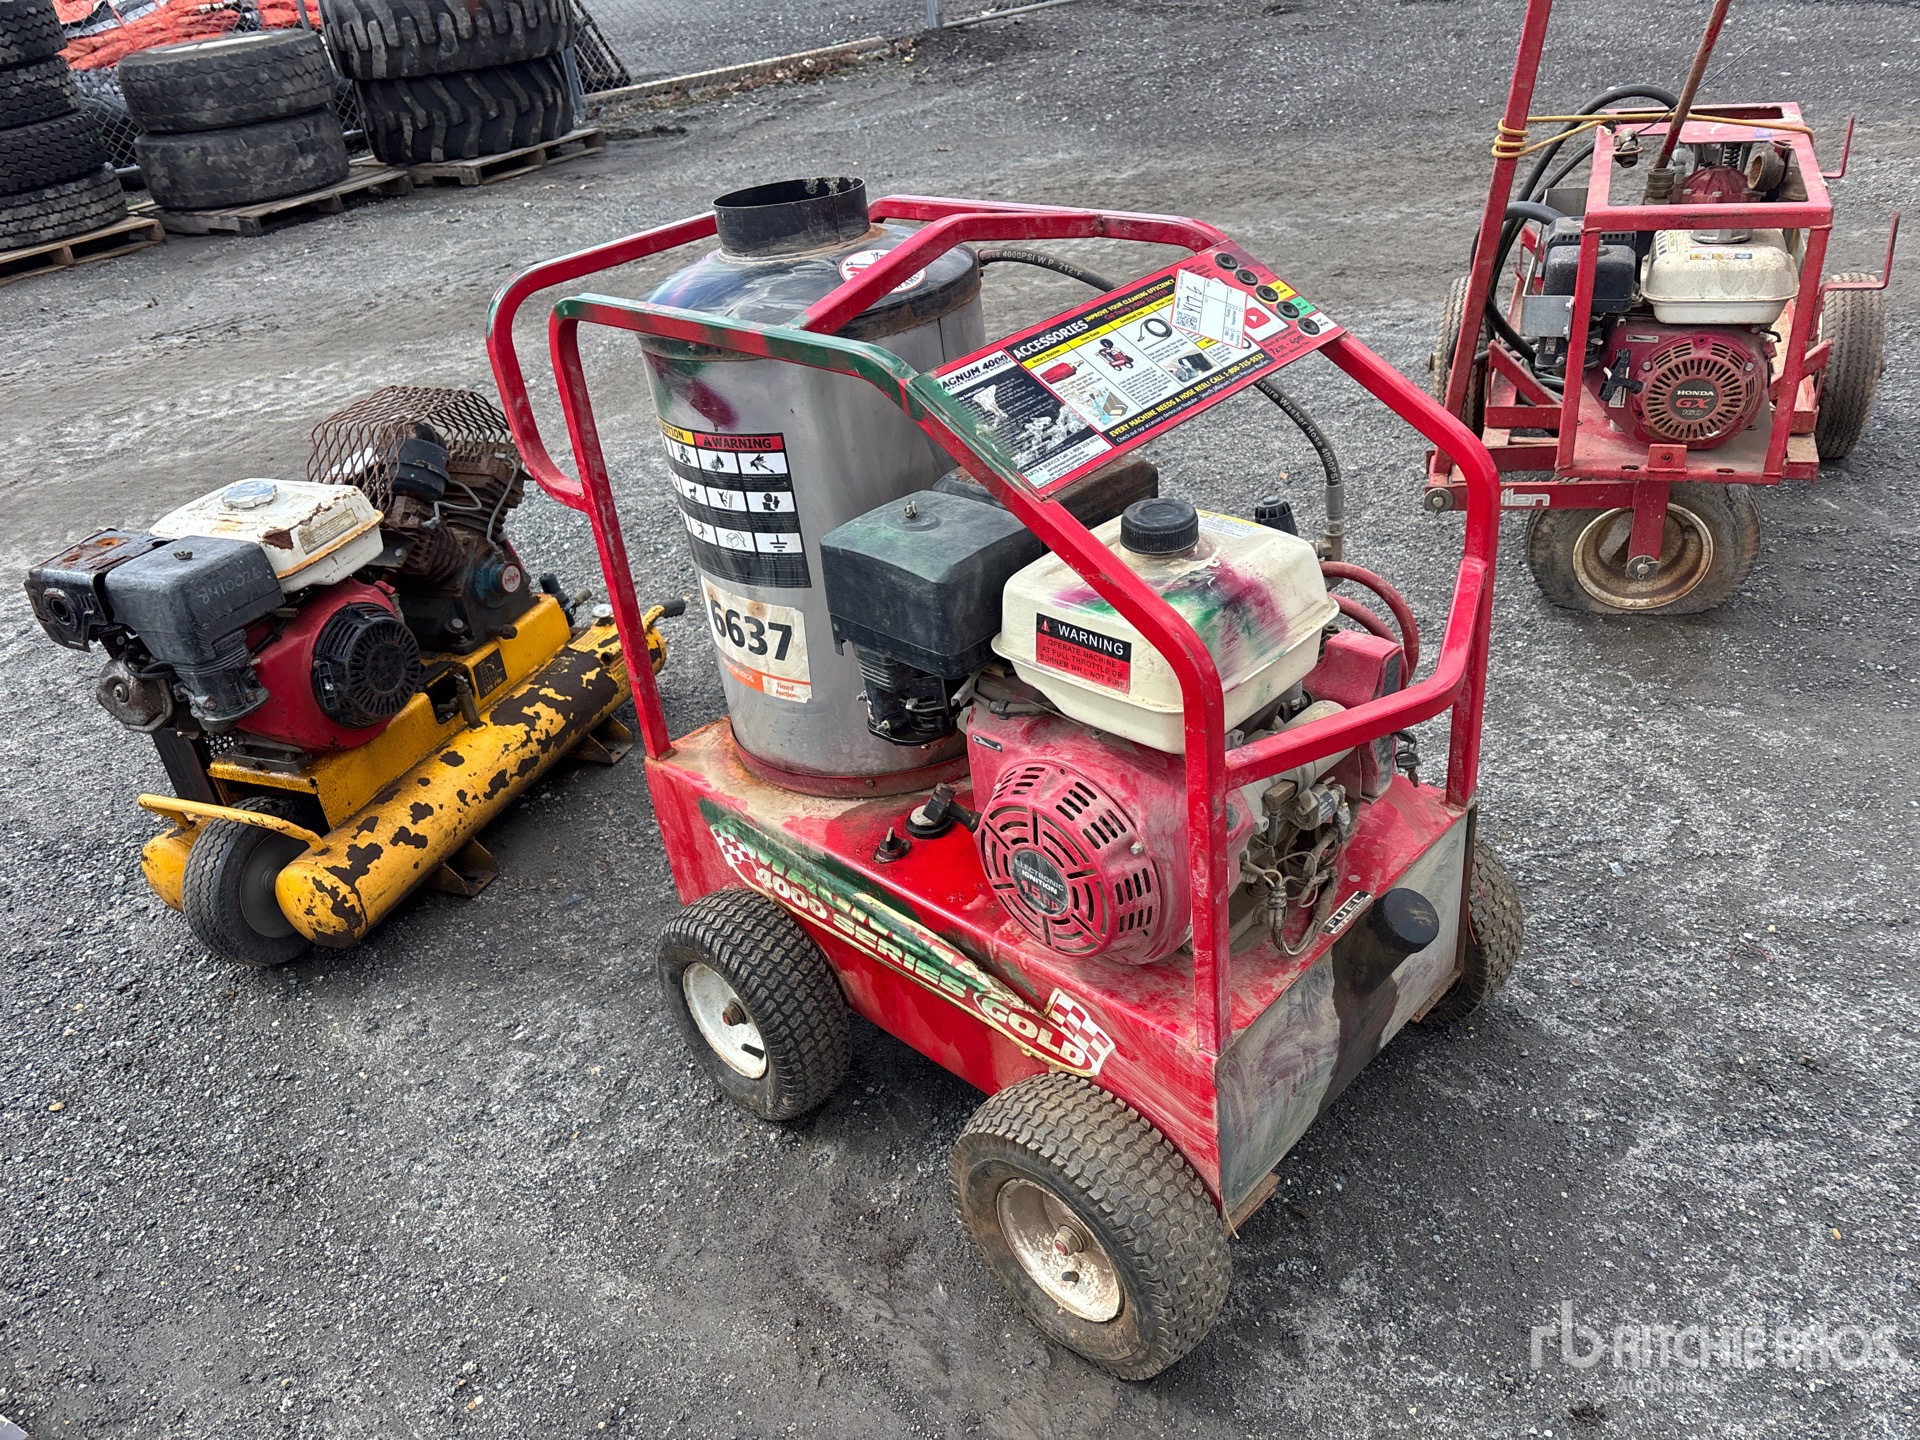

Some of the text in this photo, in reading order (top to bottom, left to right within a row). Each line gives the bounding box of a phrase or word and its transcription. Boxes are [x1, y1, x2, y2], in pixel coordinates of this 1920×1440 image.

[1002, 250, 1036, 262] 4000PSI
[1106, 301, 1124, 311] YOUR
[1120, 290, 1149, 304] CLEANING
[1145, 278, 1176, 294] EFFICIENCY
[1008, 319, 1090, 359] ACCESSORIES
[1267, 343, 1287, 354] 7am
[979, 353, 1009, 371] 4000
[1108, 423, 1131, 437] EVERY
[1127, 409, 1158, 426] MACHINE
[1154, 399, 1177, 412] NEEDS
[1178, 388, 1197, 400] HOSE
[1193, 380, 1212, 392] REEL!
[1208, 373, 1225, 383] CALL
[1221, 352, 1265, 376] 1-800-315-5533
[1675, 397, 1712, 409] GX
[711, 437, 772, 449] WARNING
[1279, 396, 1308, 427] Washer
[1305, 424, 1323, 447] Hose
[1321, 447, 1339, 483] 4000PSI
[710, 599, 793, 661] 6637
[1058, 623, 1124, 656] WARNING
[1040, 653, 1069, 669] BURNER
[1071, 664, 1088, 676] WILL
[1090, 671, 1105, 681] NOT
[1041, 645, 1123, 679] AT FULL THROTTLE OR
[1048, 638, 1117, 668] OPERATE MACHINE
[775, 689, 798, 699] Auction
[776, 682, 794, 691] Timed
[1015, 858, 1064, 891] ELECTRONIC
[1020, 880, 1041, 900] 15
[1021, 869, 1058, 895] IGNITION
[1327, 896, 1365, 928] FUEL
[756, 867, 968, 999] 4000 SERIES
[981, 997, 1086, 1067] GOLD
